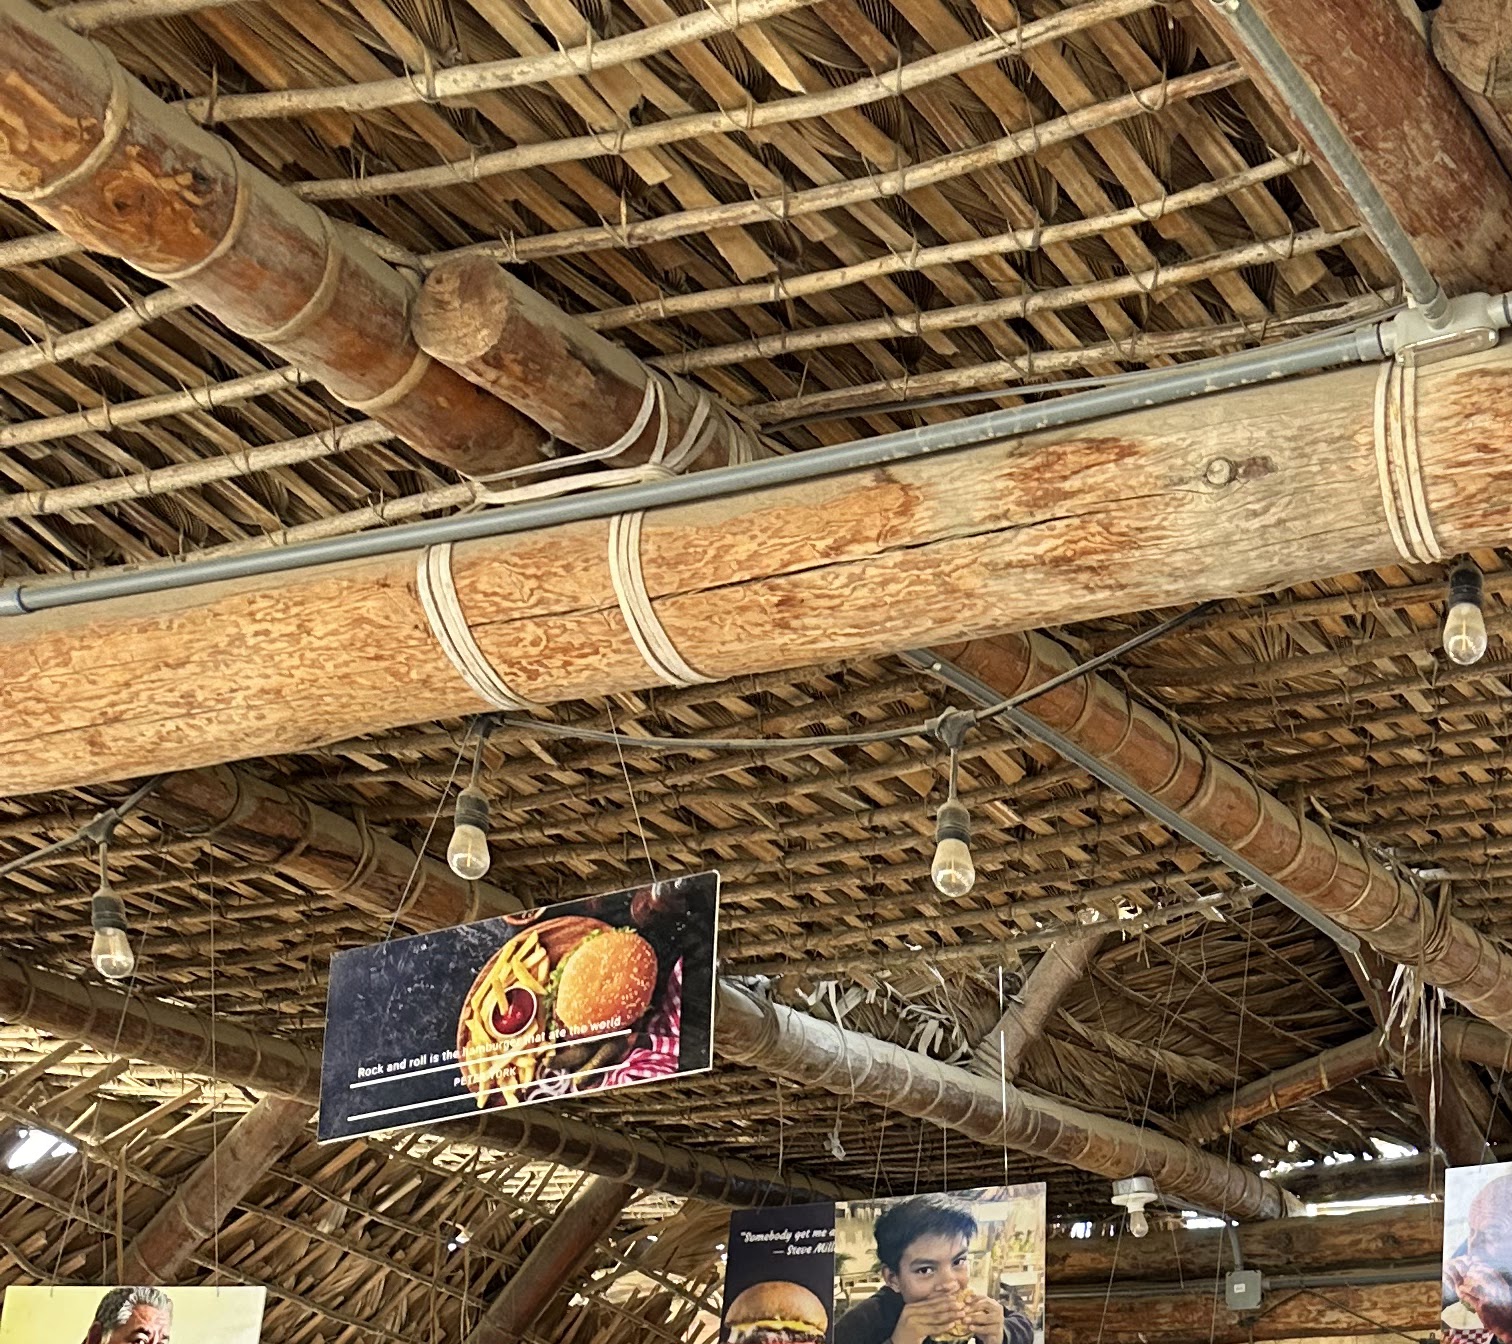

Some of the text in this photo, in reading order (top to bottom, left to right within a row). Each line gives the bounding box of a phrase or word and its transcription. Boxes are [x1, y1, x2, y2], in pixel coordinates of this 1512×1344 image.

[358, 1064, 384, 1078] Rock
[386, 1058, 406, 1072] and
[409, 1054, 426, 1068] roll
[430, 1053, 439, 1064] is
[442, 1050, 460, 1062] the
[549, 1028, 566, 1040] ate
[570, 1024, 588, 1036] the
[590, 1016, 622, 1032] world
[794, 1229, 810, 1242] get
[812, 1229, 827, 1238] me
[786, 1244, 812, 1256] Steve
